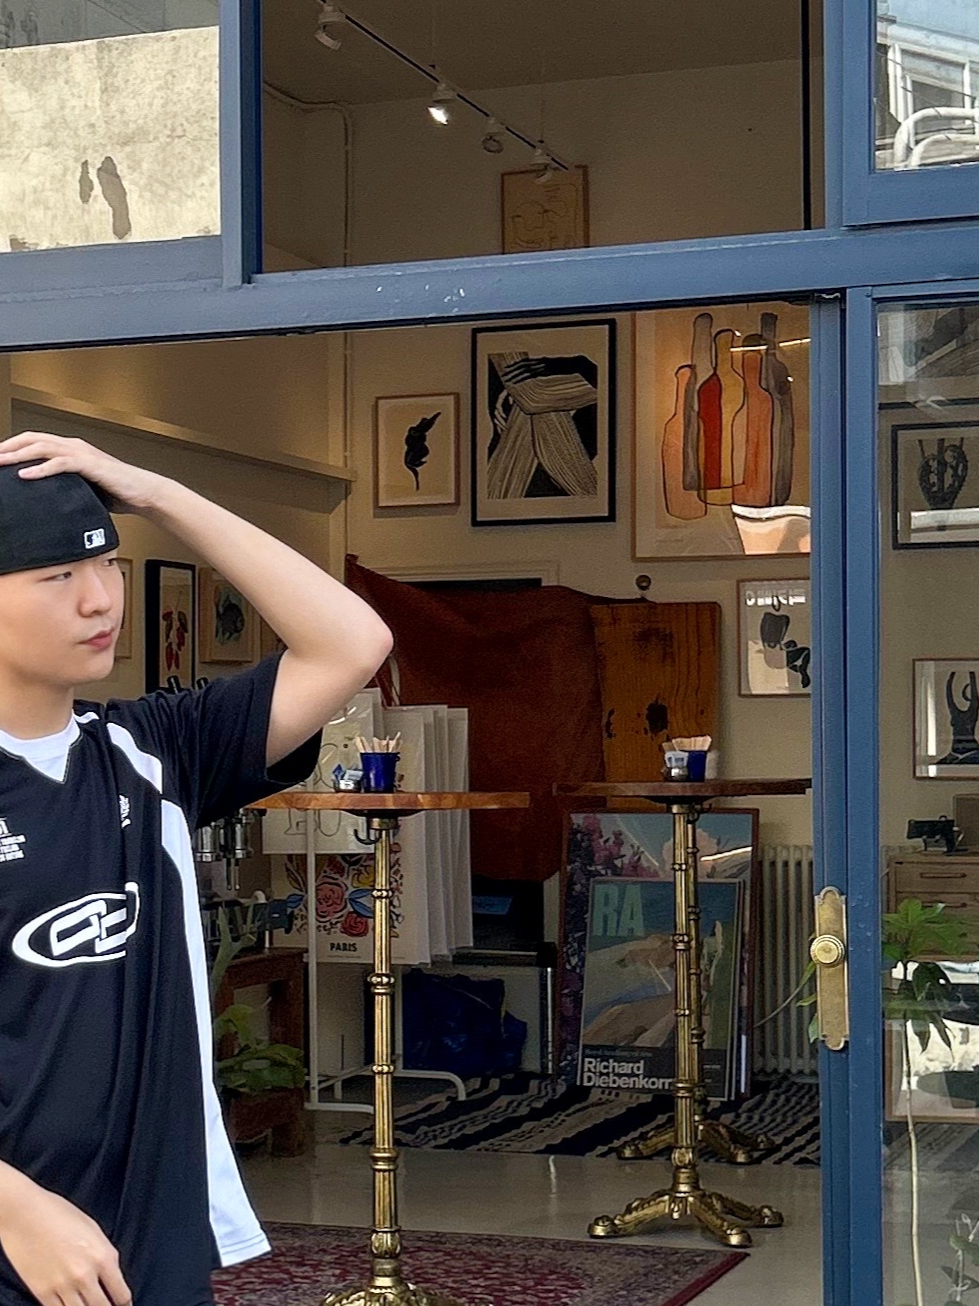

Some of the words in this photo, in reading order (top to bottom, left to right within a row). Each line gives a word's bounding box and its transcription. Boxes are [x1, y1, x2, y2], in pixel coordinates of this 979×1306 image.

[593, 884, 644, 937] RA
[330, 942, 358, 952] PARIS
[583, 1057, 645, 1075] Richard
